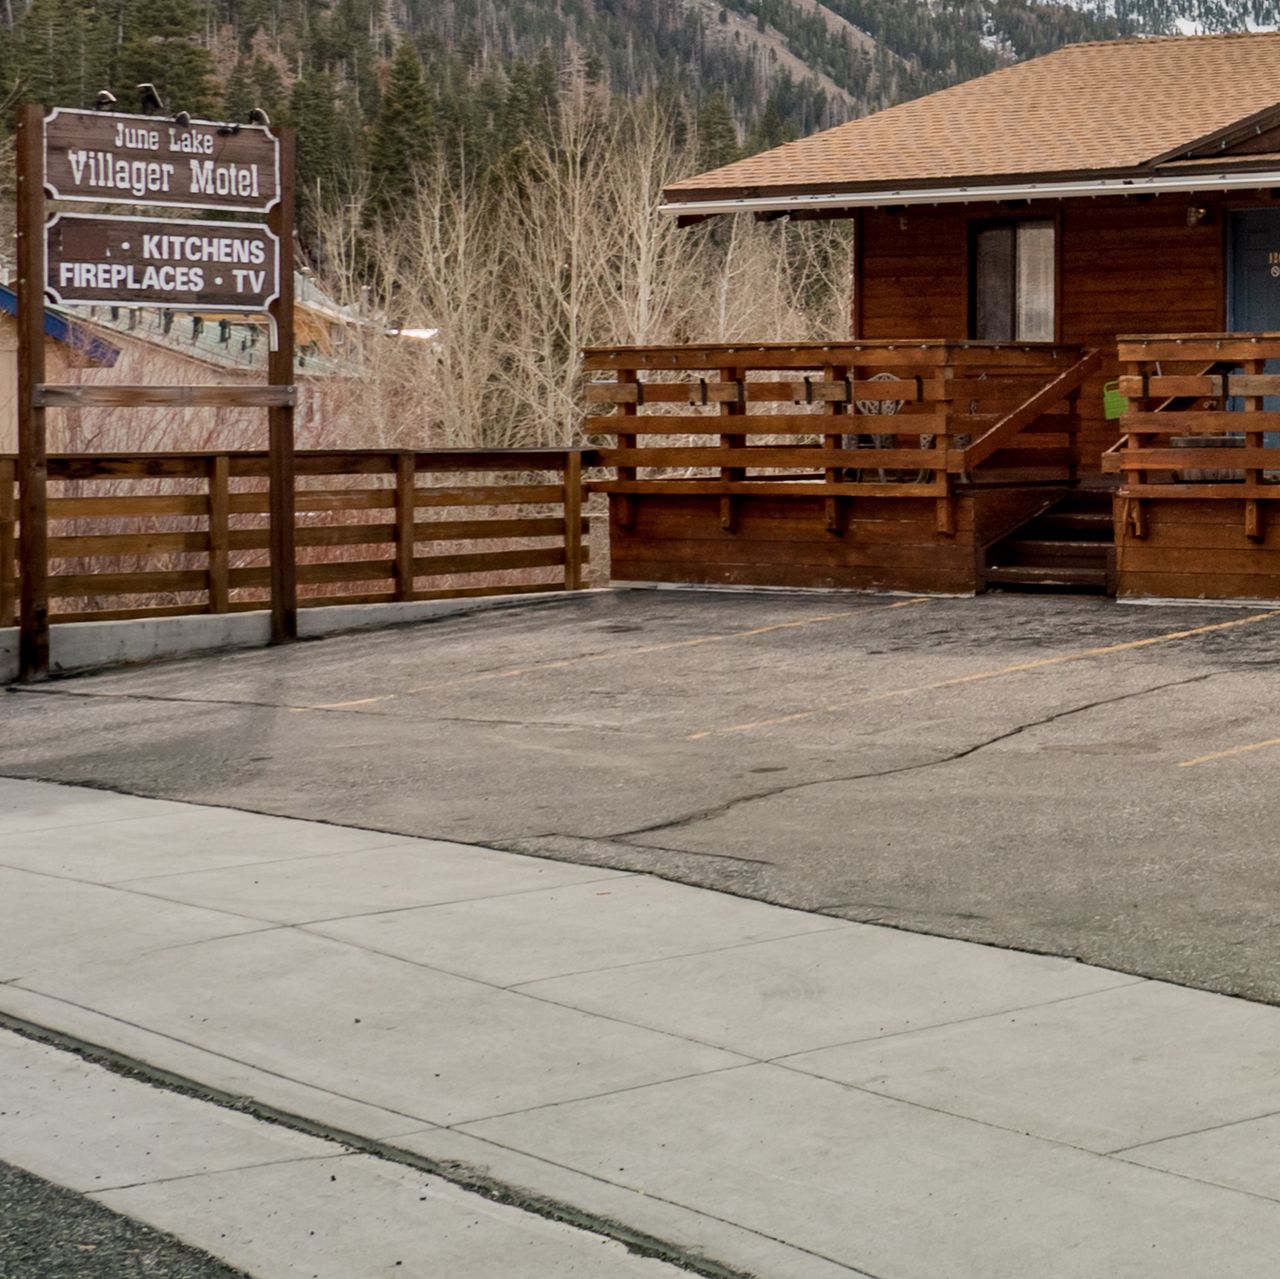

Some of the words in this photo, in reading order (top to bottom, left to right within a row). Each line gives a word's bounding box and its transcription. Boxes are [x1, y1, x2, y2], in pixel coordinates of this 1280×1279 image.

[115, 123, 159, 150] June
[169, 128, 213, 154] Lake
[68, 150, 174, 196] Villager
[190, 159, 259, 197] Motel
[143, 234, 265, 264] KITCHENS
[60, 262, 204, 292] FIREPLACES
[232, 271, 265, 294] TV
